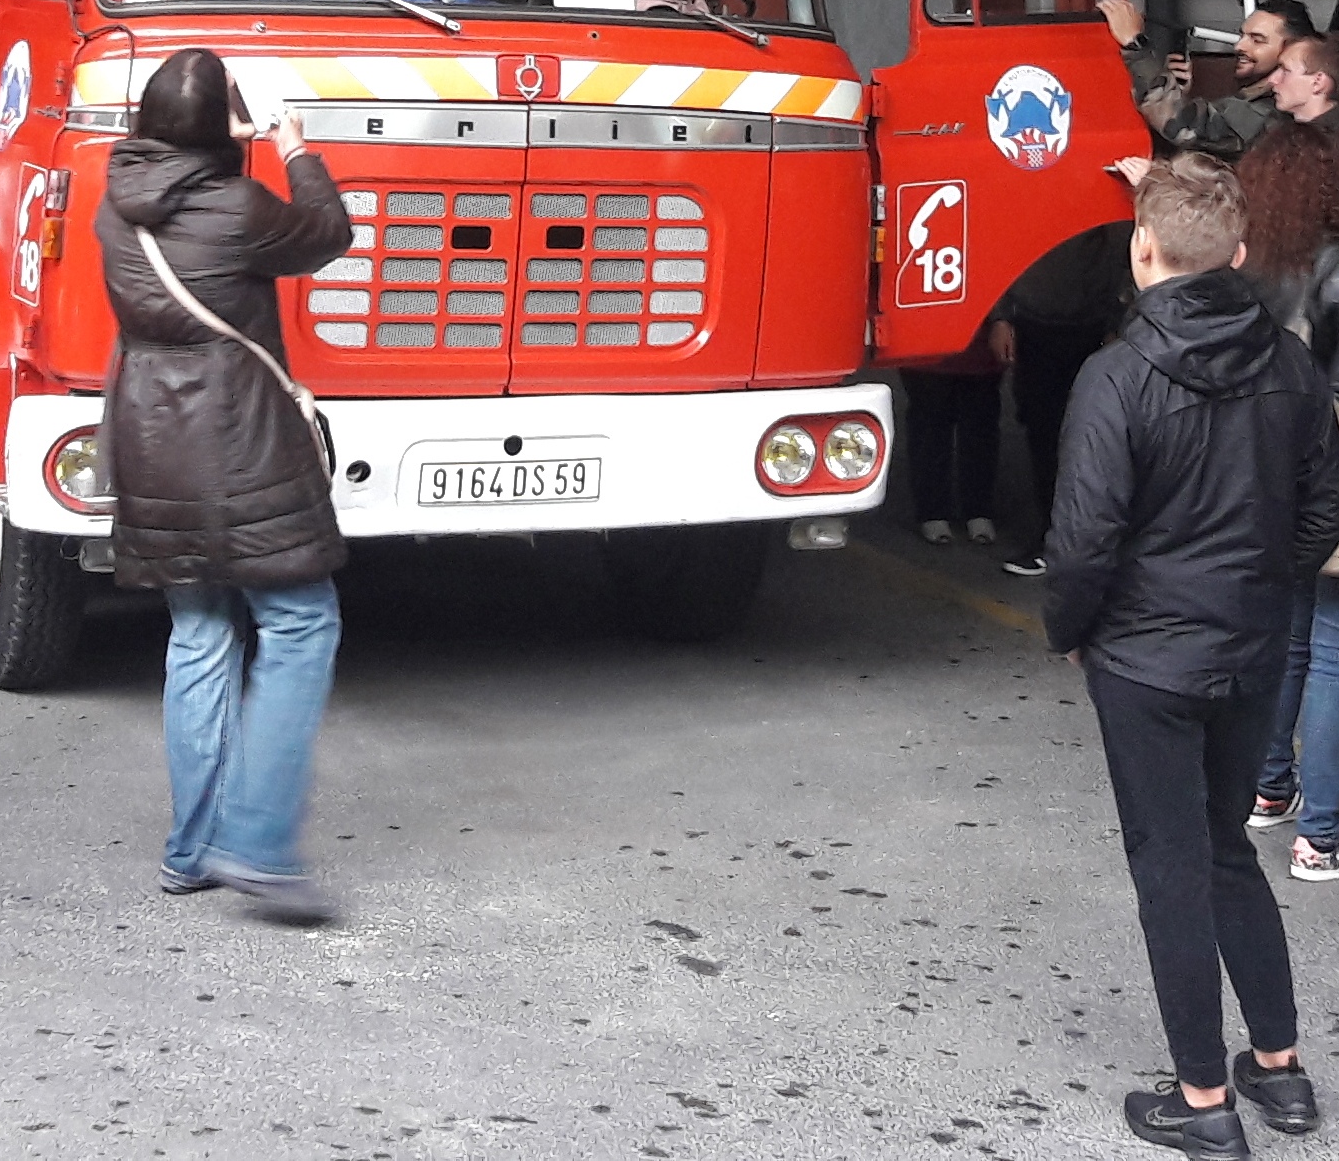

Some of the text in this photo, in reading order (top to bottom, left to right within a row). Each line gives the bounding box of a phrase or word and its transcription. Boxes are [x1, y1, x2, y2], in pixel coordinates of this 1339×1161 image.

[19, 239, 40, 293] 18
[915, 246, 962, 293] 18
[432, 463, 586, 499] 9164 DS 59
